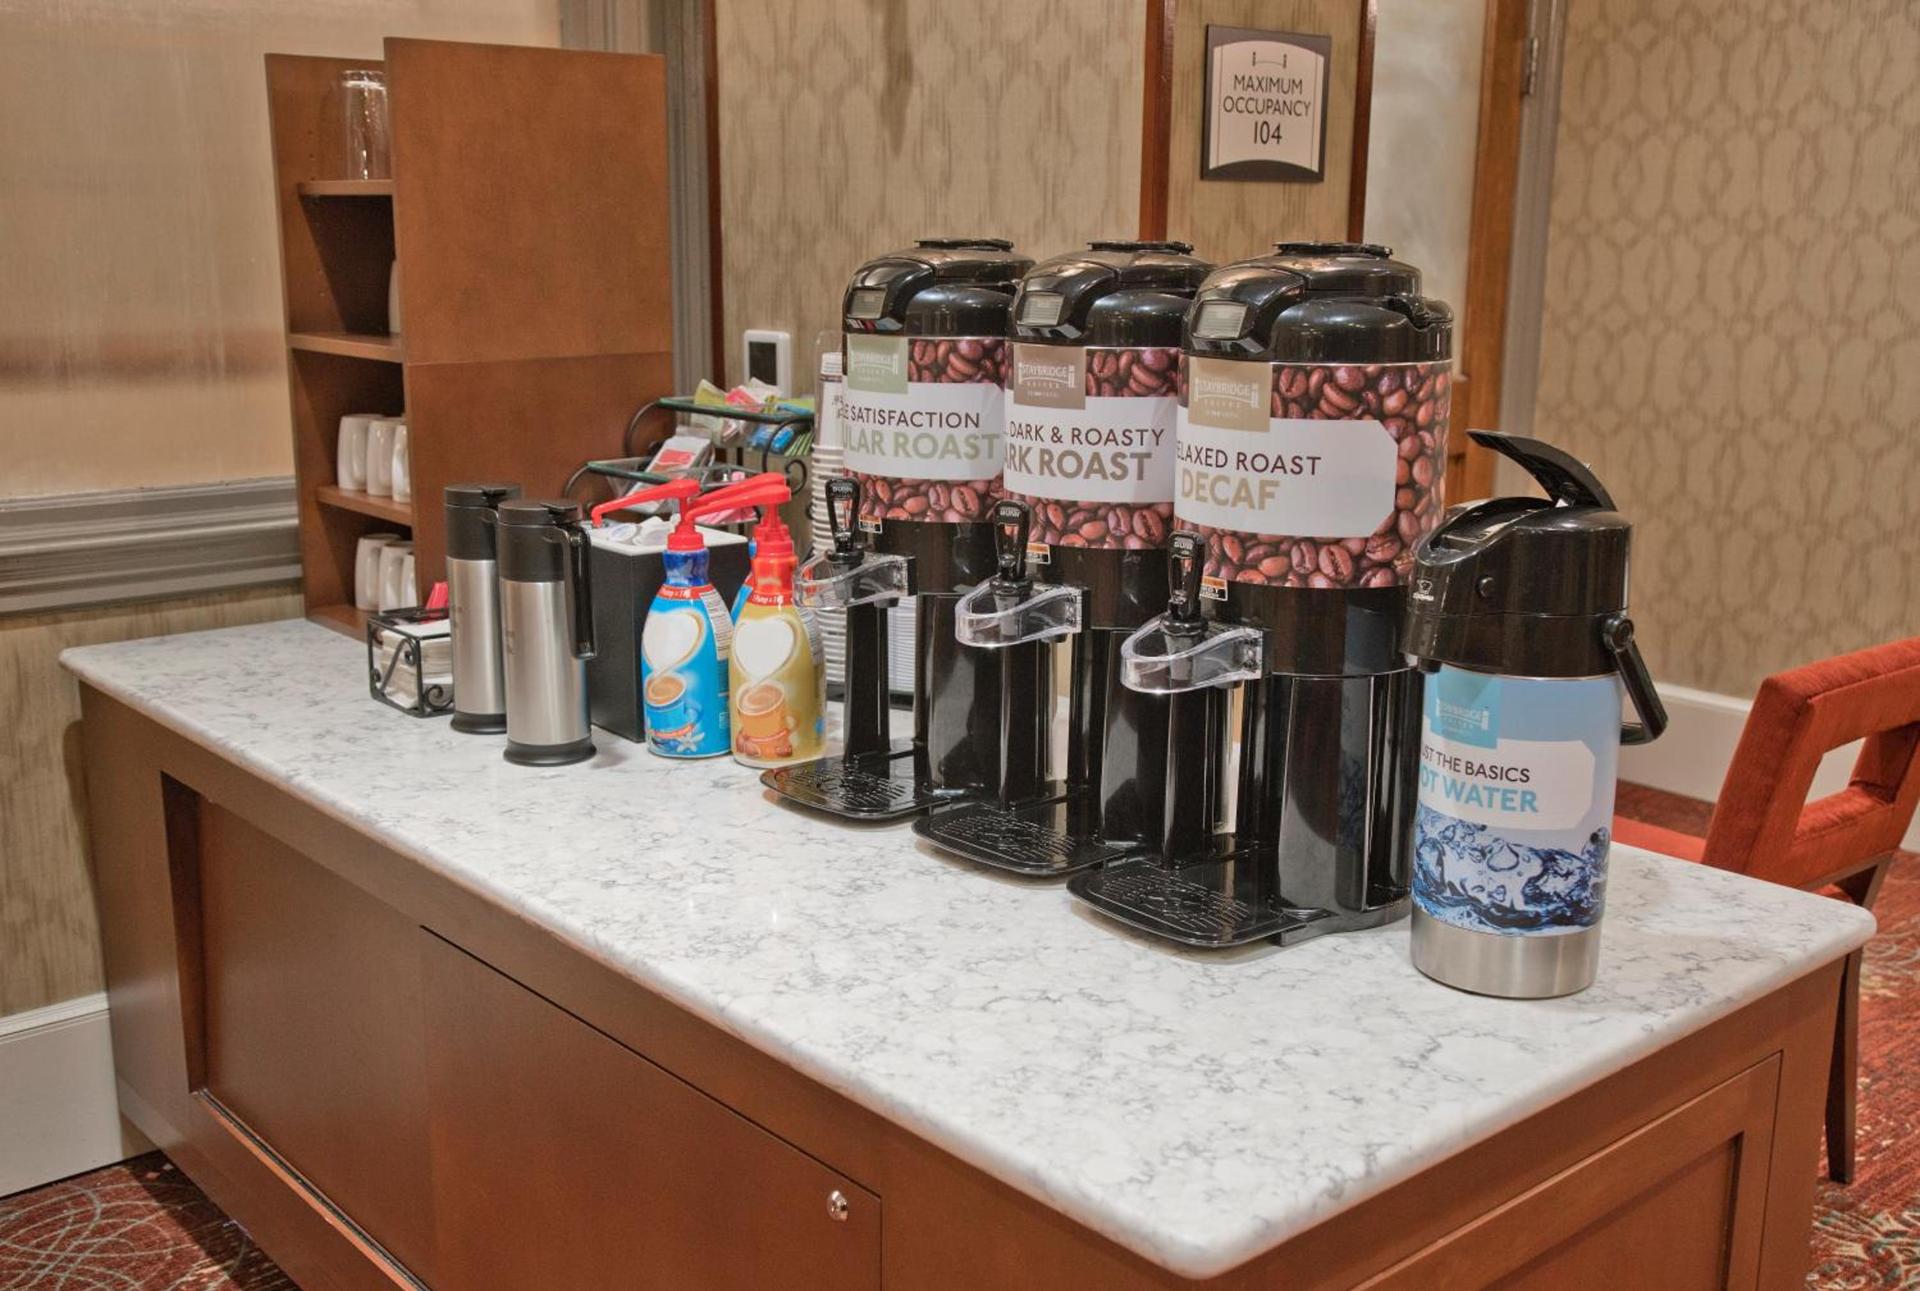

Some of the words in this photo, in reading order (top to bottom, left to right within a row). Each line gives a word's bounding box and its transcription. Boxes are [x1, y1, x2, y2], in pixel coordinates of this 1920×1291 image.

[1233, 75, 1303, 95] MAXIMUM
[1223, 96, 1311, 117] OCCUPANCY
[1254, 121, 1283, 145] 104
[851, 404, 980, 429] SATISFACTION
[894, 432, 1001, 461] ROAST
[1010, 420, 1045, 443] DARK
[1051, 426, 1064, 444] &
[1071, 427, 1165, 447] ROASTY
[1039, 447, 1153, 482] ROAST
[1236, 451, 1322, 476] ROAST
[1181, 468, 1281, 511] DECAF
[1436, 751, 1462, 773] THE
[1465, 760, 1531, 784] BASICS
[1442, 774, 1539, 813] WATER
